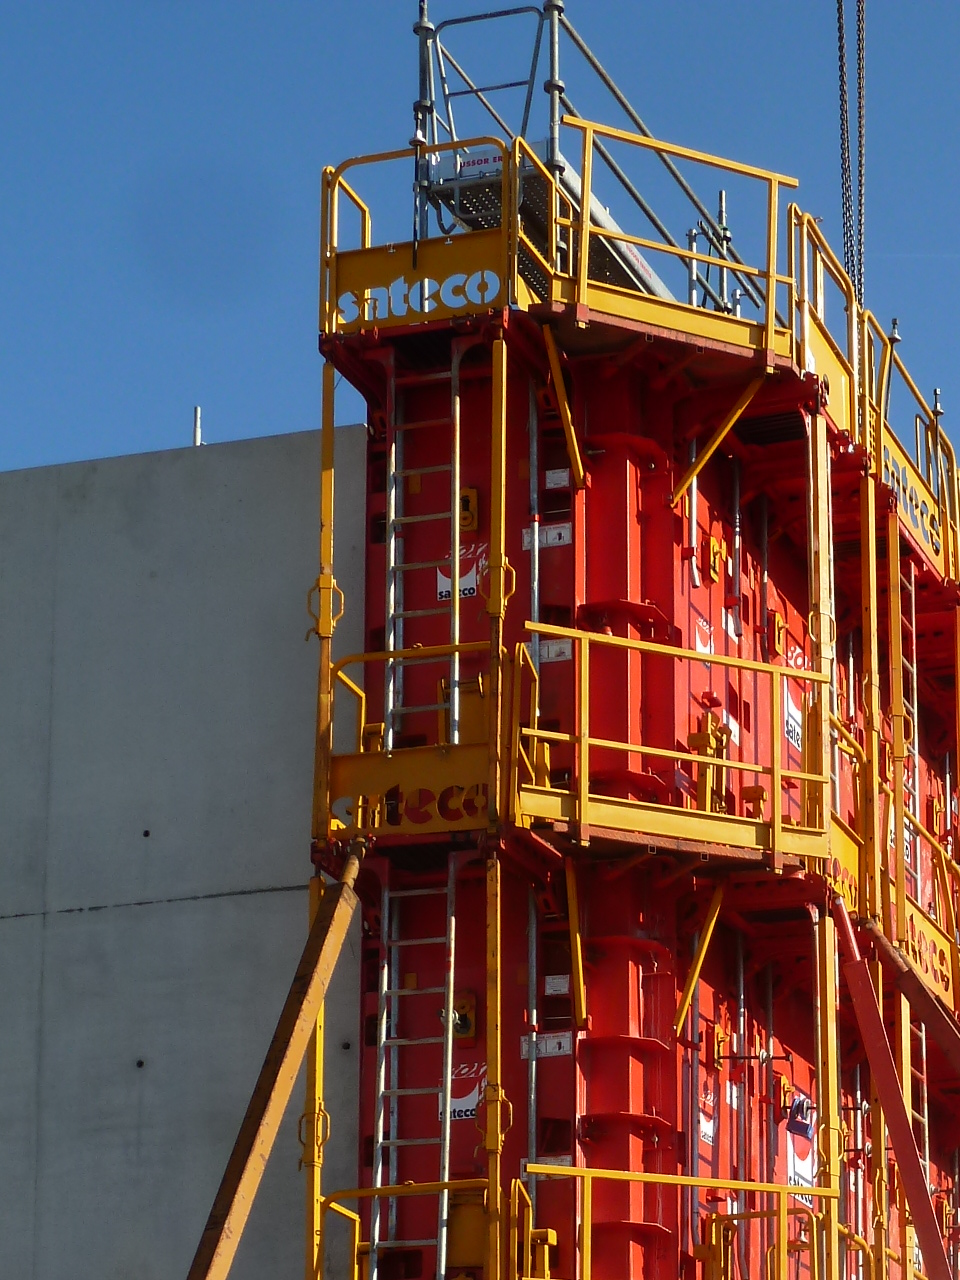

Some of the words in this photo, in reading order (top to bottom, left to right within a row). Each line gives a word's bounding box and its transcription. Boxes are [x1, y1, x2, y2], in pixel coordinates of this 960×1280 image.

[453, 157, 490, 169] USSOR
[337, 269, 500, 325] sateco
[438, 586, 476, 601] saeco
[905, 912, 950, 993] teco
